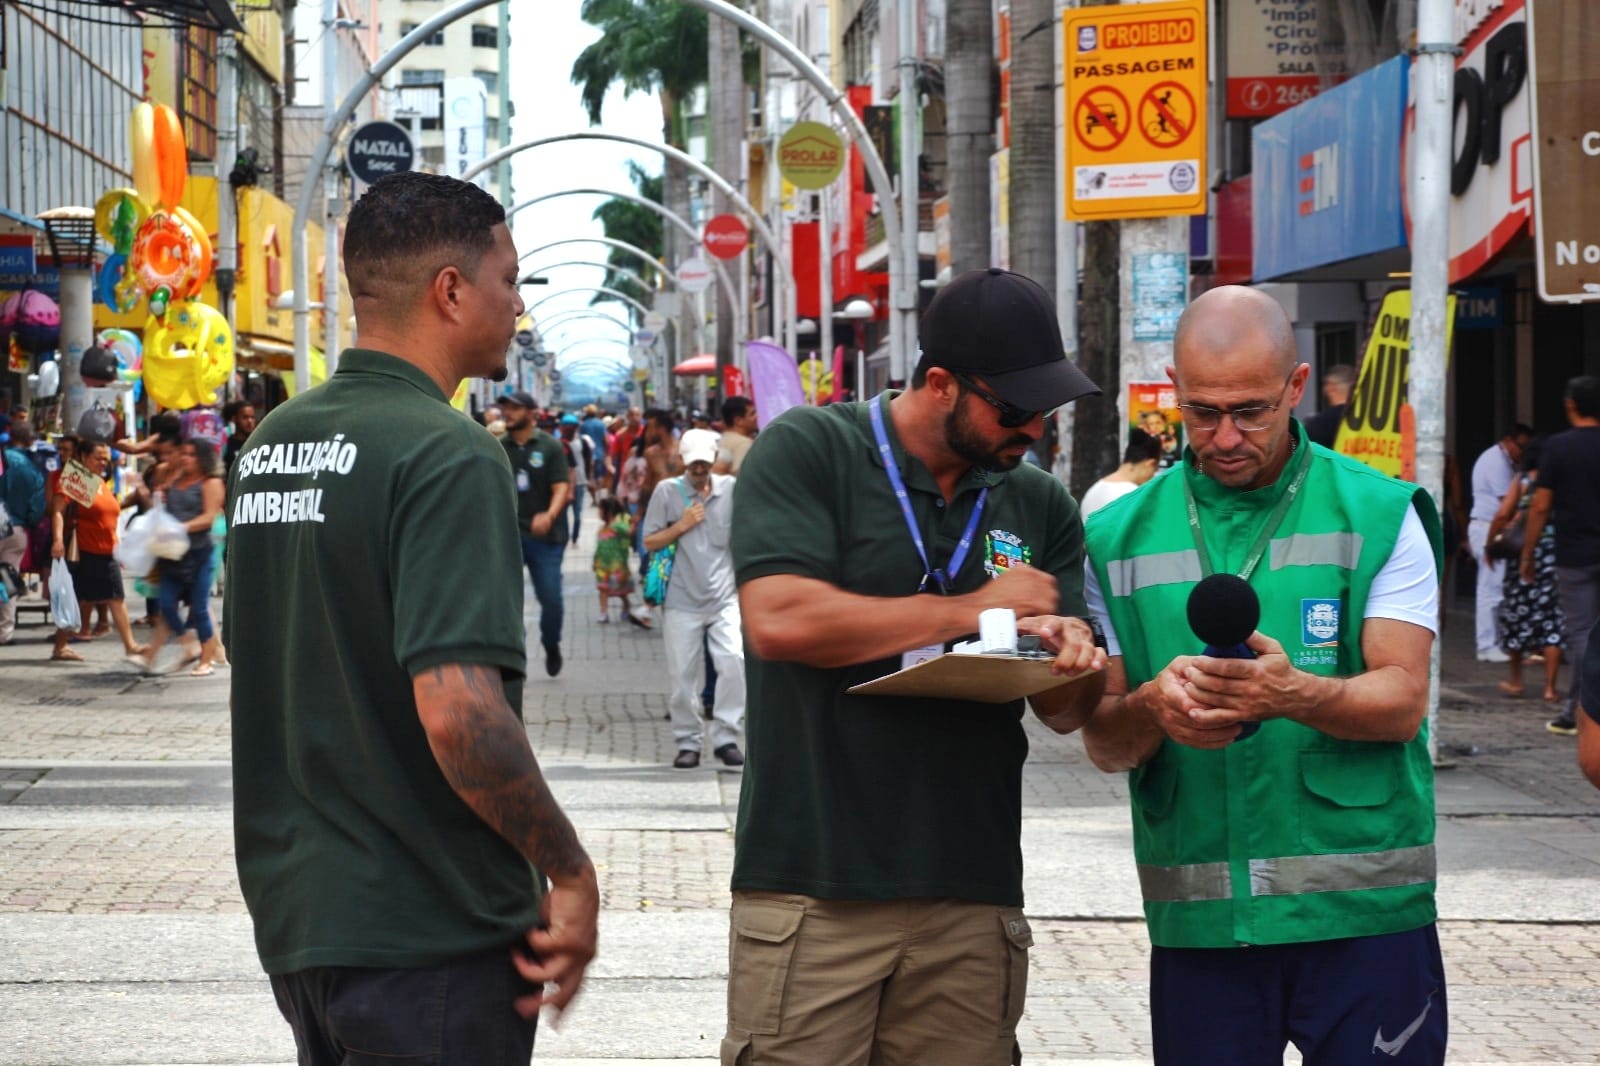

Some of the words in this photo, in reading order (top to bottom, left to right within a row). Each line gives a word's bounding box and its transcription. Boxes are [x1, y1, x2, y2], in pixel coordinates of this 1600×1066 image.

[1106, 20, 1191, 47] PROIBIDO
[1073, 57, 1195, 79] PASSAGEM
[1278, 62, 1315, 74] SALA
[354, 139, 410, 157] NATAL
[782, 150, 838, 162] PROLAR
[1457, 298, 1497, 318] TIM
